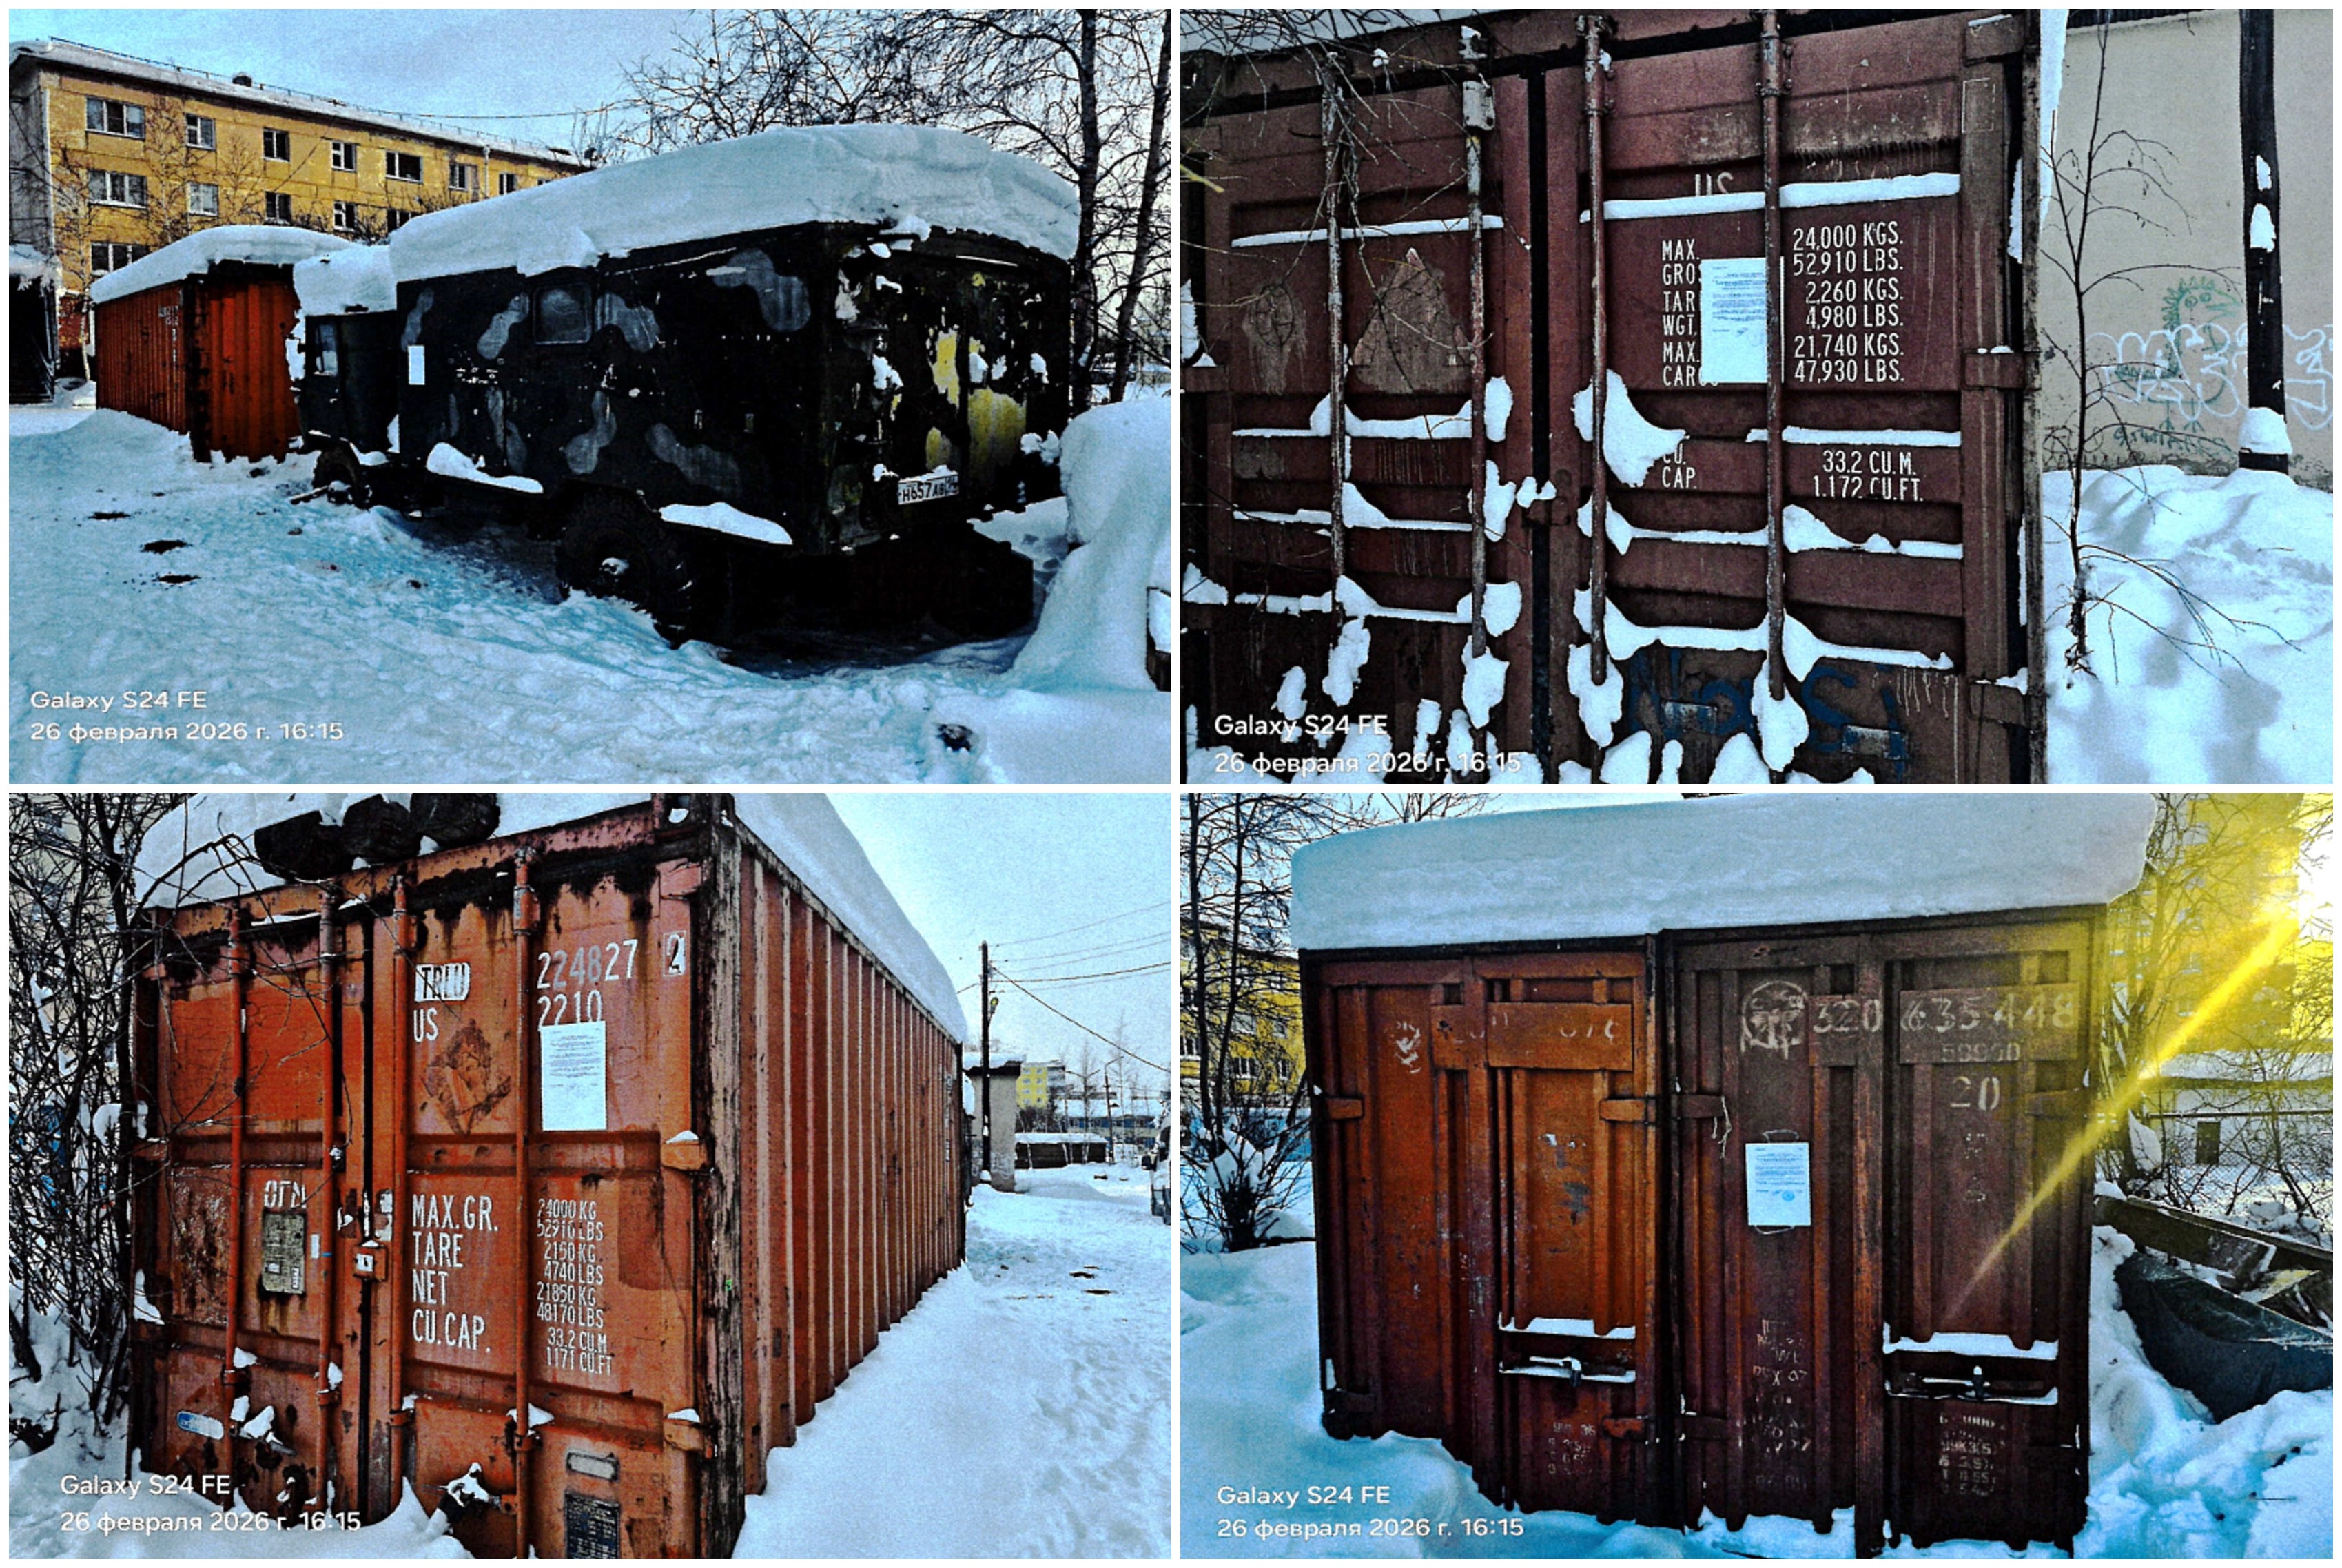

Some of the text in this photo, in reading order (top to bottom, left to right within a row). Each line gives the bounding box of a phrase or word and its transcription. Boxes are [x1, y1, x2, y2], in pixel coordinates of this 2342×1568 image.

[1661, 220, 1904, 261] MAX. 24,000 KGS.
[1862, 247, 1904, 272] LBS.
[1863, 276, 1904, 302] KGS.
[1863, 303, 1904, 328] LBS.
[1662, 332, 1905, 363] MAX. 21,740 KGS.
[1661, 358, 1905, 387] CAR 47,930 LBS.
[1822, 449, 1863, 473] 33.2
[1661, 466, 1698, 489] CAP.
[537, 938, 639, 991] 224827
[537, 989, 604, 1032] 2210
[413, 1007, 439, 1042] US
[1950, 1075, 2000, 1111] 20
[537, 1198, 577, 1219] 24000
[579, 1200, 597, 1221] KG
[537, 1219, 604, 1242] 52910 LBS
[413, 1231, 464, 1268] TARE
[578, 1243, 596, 1263] KG
[544, 1260, 604, 1285] 4740 LBS
[413, 1269, 596, 1307] NET 21850 KG
[537, 1302, 604, 1329] 48170 LBS
[548, 1326, 575, 1349] 33.2
[546, 1345, 575, 1370] 1171
